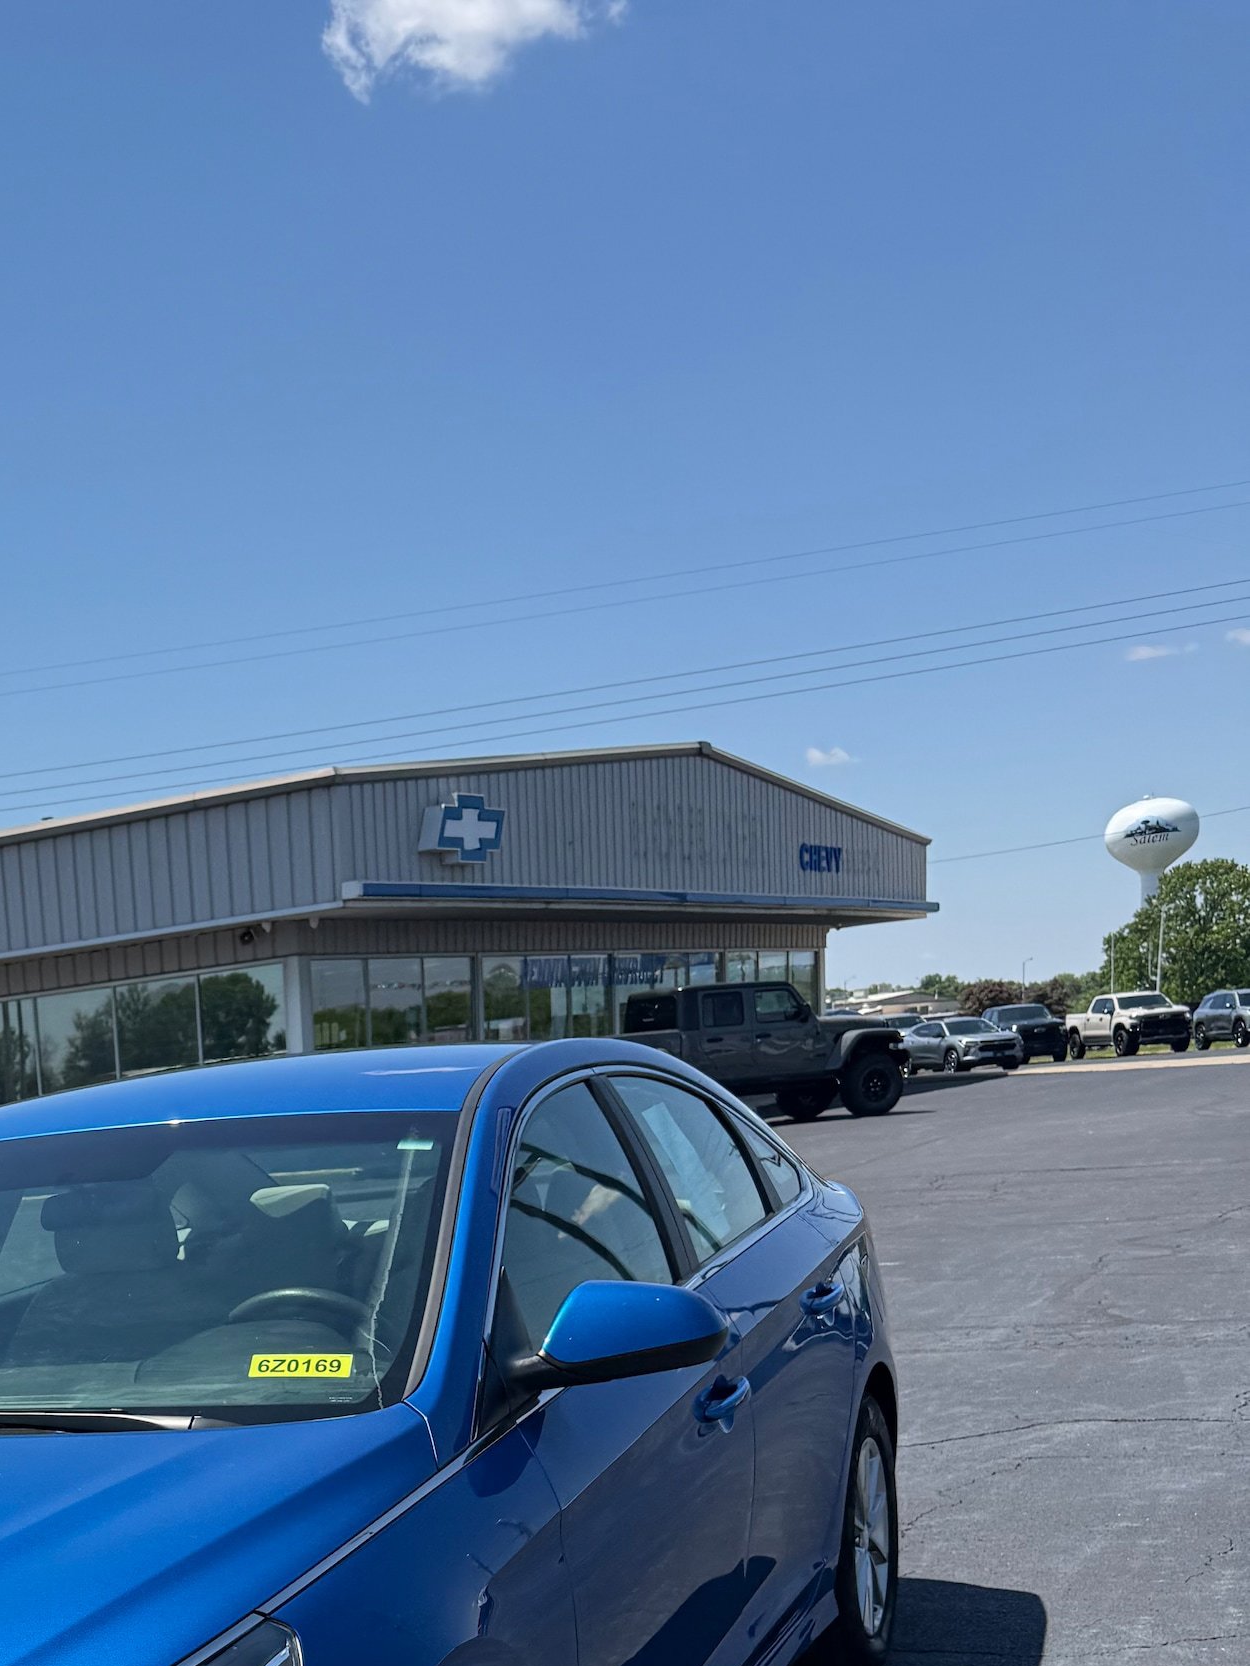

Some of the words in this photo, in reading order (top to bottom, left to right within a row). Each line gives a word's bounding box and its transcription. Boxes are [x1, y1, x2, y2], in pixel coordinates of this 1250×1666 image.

[1130, 832, 1169, 847] Salem
[800, 843, 842, 873] CHEVY
[257, 1358, 342, 1373] 6Z0169
